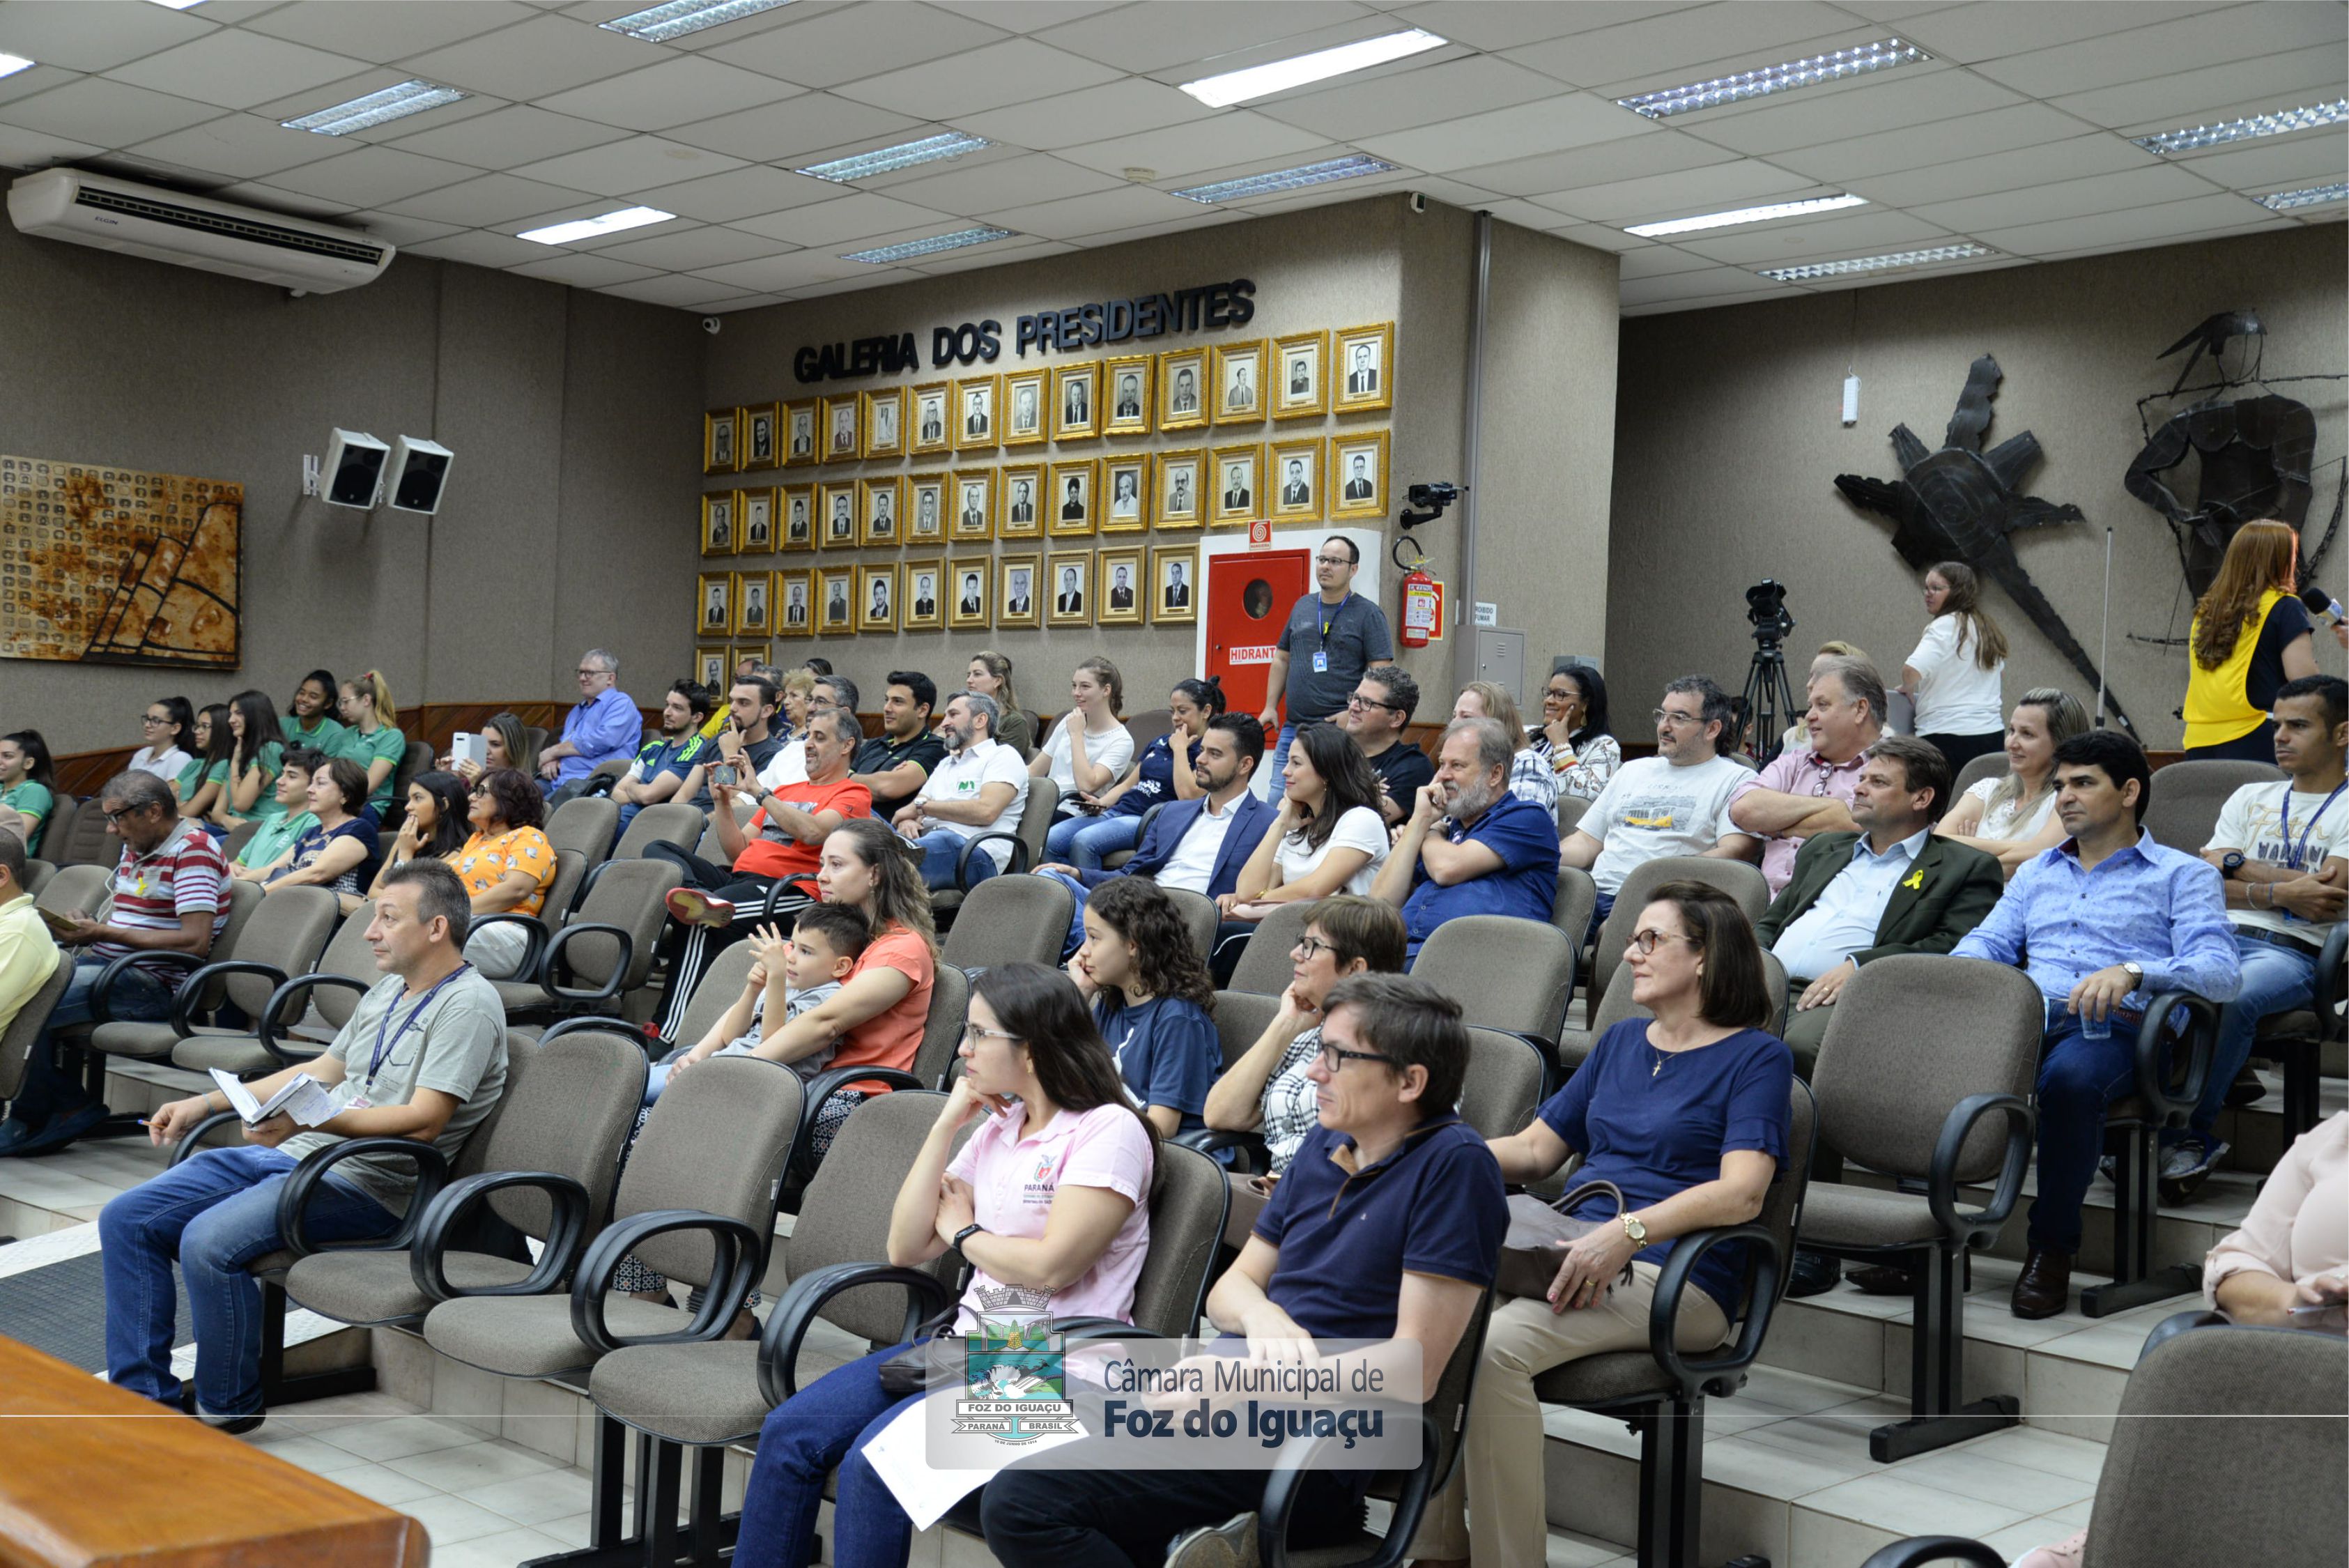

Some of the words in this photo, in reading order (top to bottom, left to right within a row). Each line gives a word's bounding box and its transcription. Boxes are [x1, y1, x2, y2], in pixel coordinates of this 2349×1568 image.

[794, 333, 919, 383] GALERIA
[932, 320, 1001, 366] DOS
[1016, 279, 1256, 355] PRESIDENTES
[1475, 606, 1494, 614] ROIBIDO
[1231, 647, 1277, 661] HIDRANT
[1024, 1182, 1055, 1192] PARANÁ
